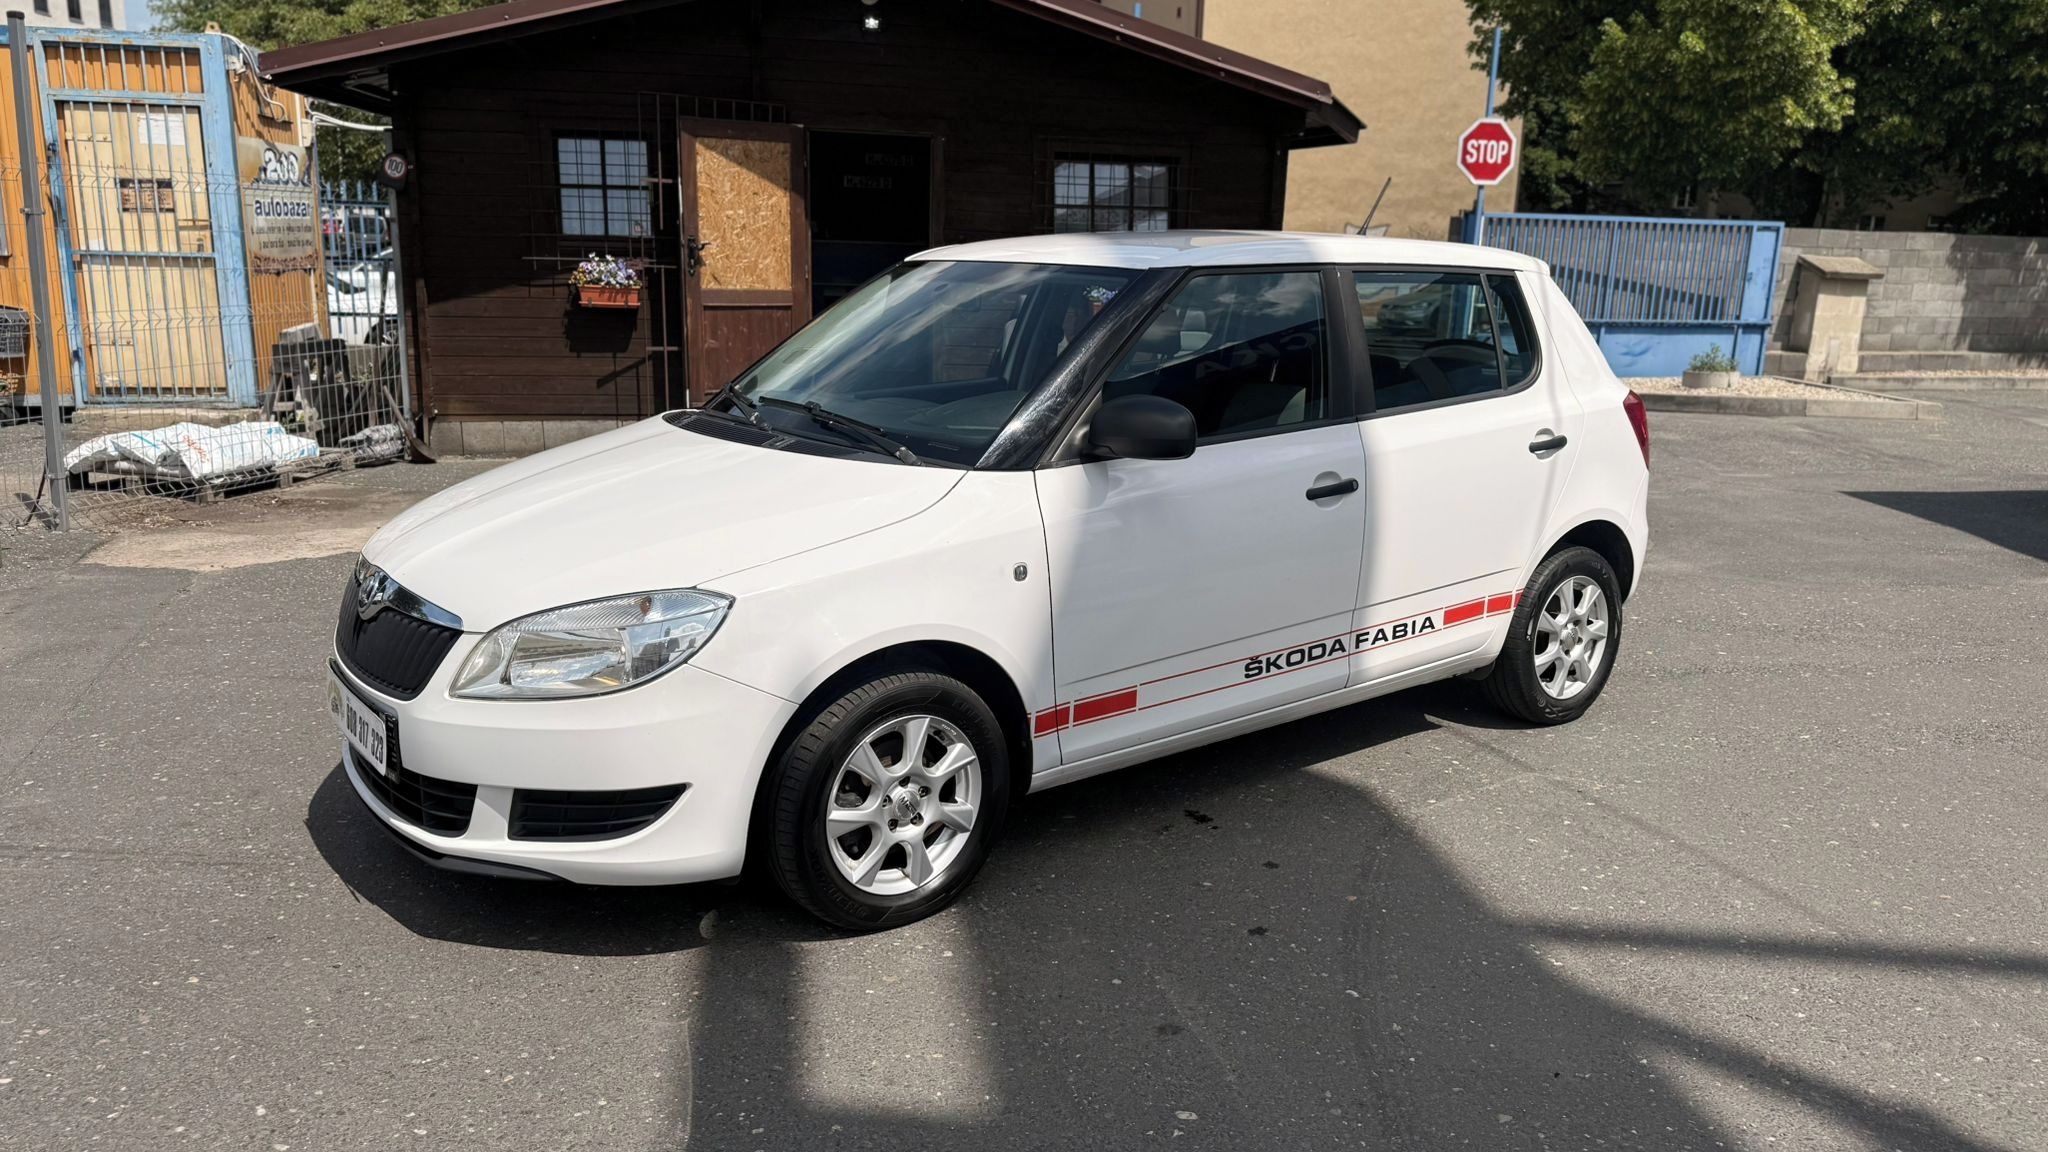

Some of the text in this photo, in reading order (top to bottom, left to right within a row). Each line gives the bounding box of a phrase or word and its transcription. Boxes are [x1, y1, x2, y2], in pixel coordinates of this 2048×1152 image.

[1465, 139, 1509, 164] STOP
[388, 159, 404, 174] 100
[1244, 616, 1436, 679] ŠKODA FABIA
